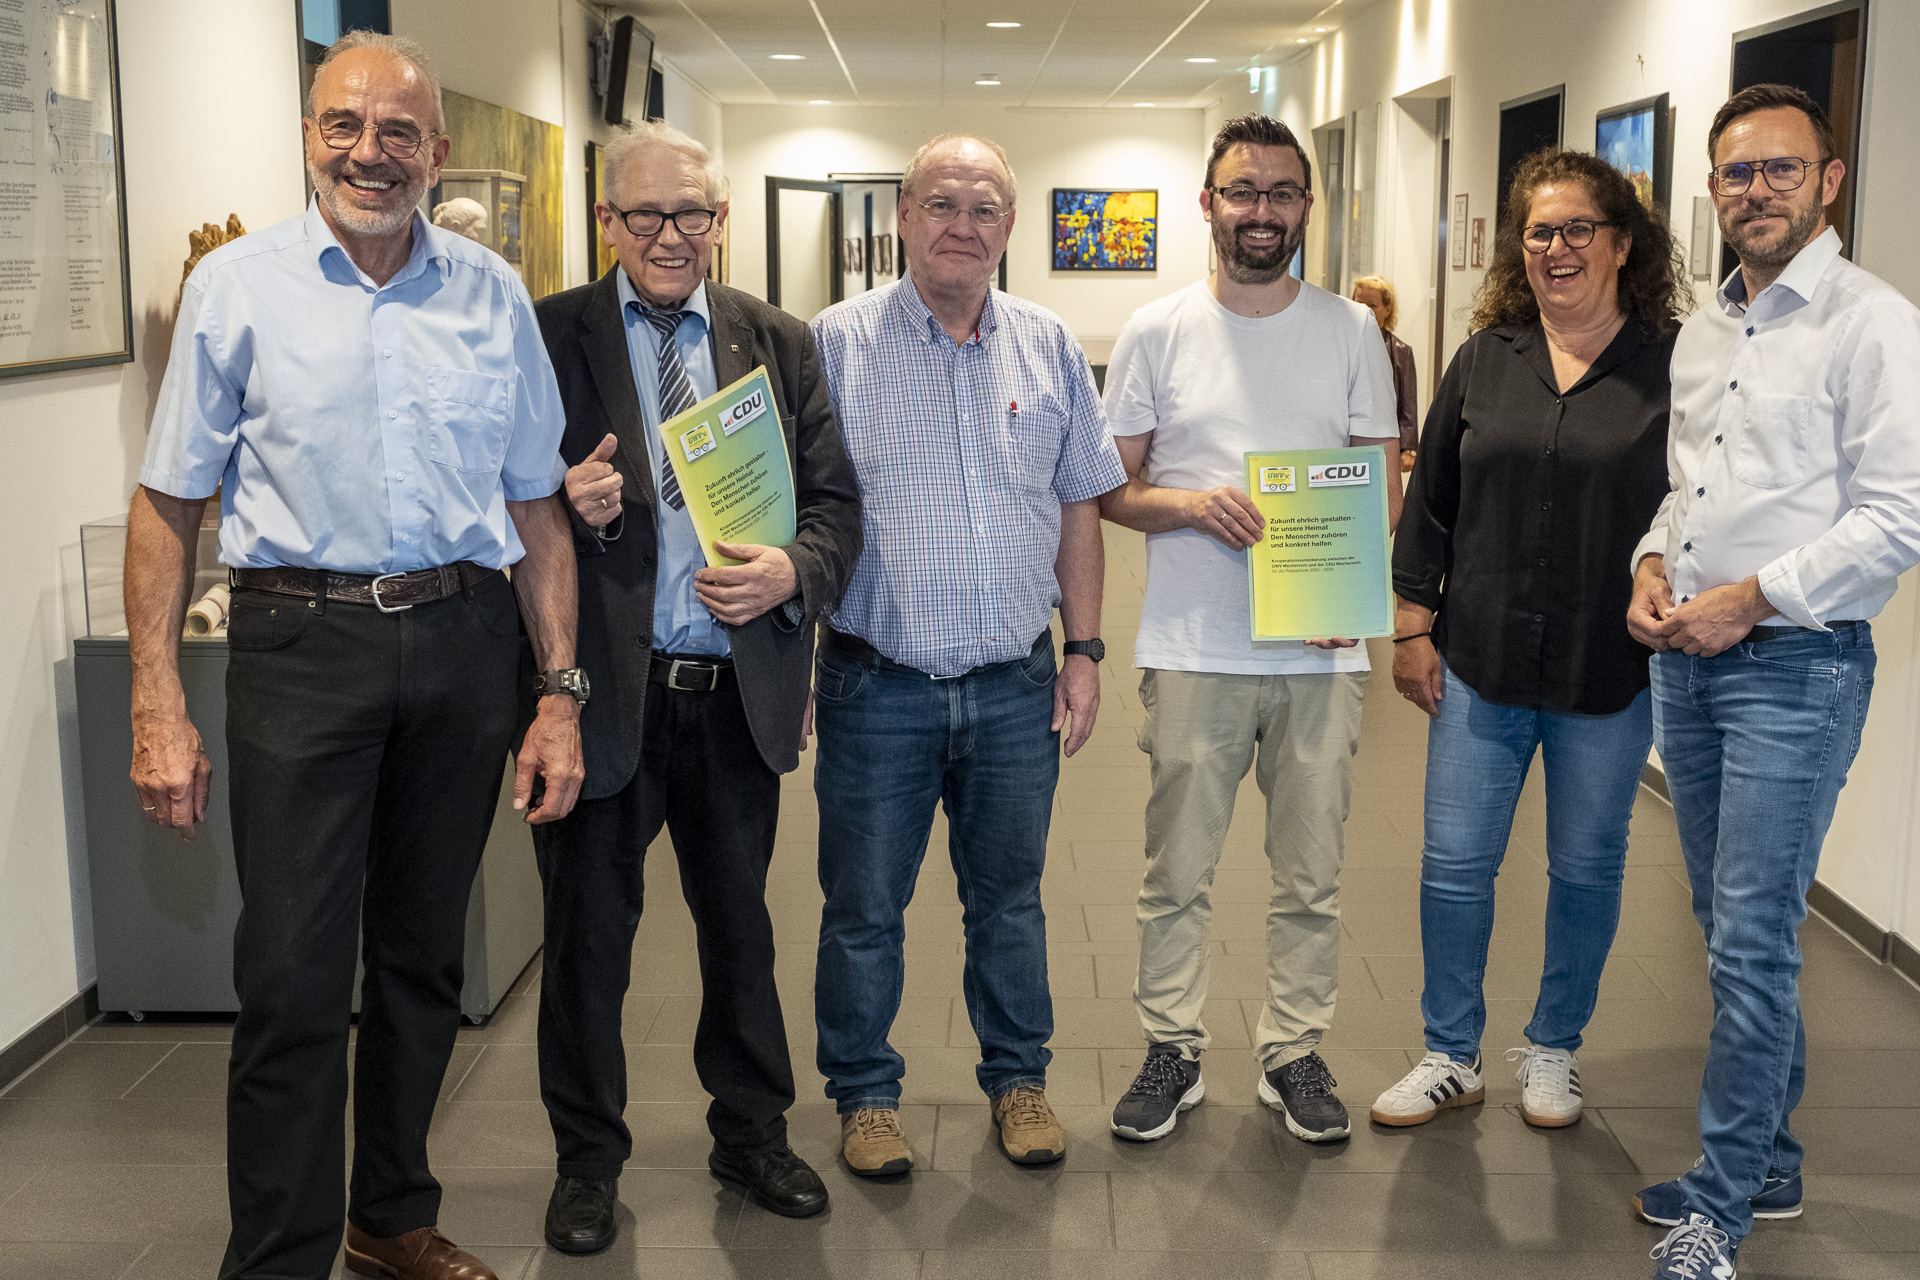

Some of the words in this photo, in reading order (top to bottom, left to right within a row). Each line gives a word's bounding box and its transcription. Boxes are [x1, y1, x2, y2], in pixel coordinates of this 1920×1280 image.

[732, 392, 762, 420] CDU
[688, 431, 702, 444] UWV
[705, 476, 727, 491] Zukunft
[727, 466, 745, 479] ehrlich
[745, 452, 766, 469] gestalten
[717, 482, 735, 494] unsere
[736, 469, 754, 483] Heimat
[1325, 466, 1366, 479] CDU
[711, 499, 723, 508] Den
[723, 482, 750, 501] Menschen
[750, 470, 768, 485] zuhören
[714, 506, 725, 516] und
[725, 494, 746, 509] konkret
[746, 485, 761, 497] helfen
